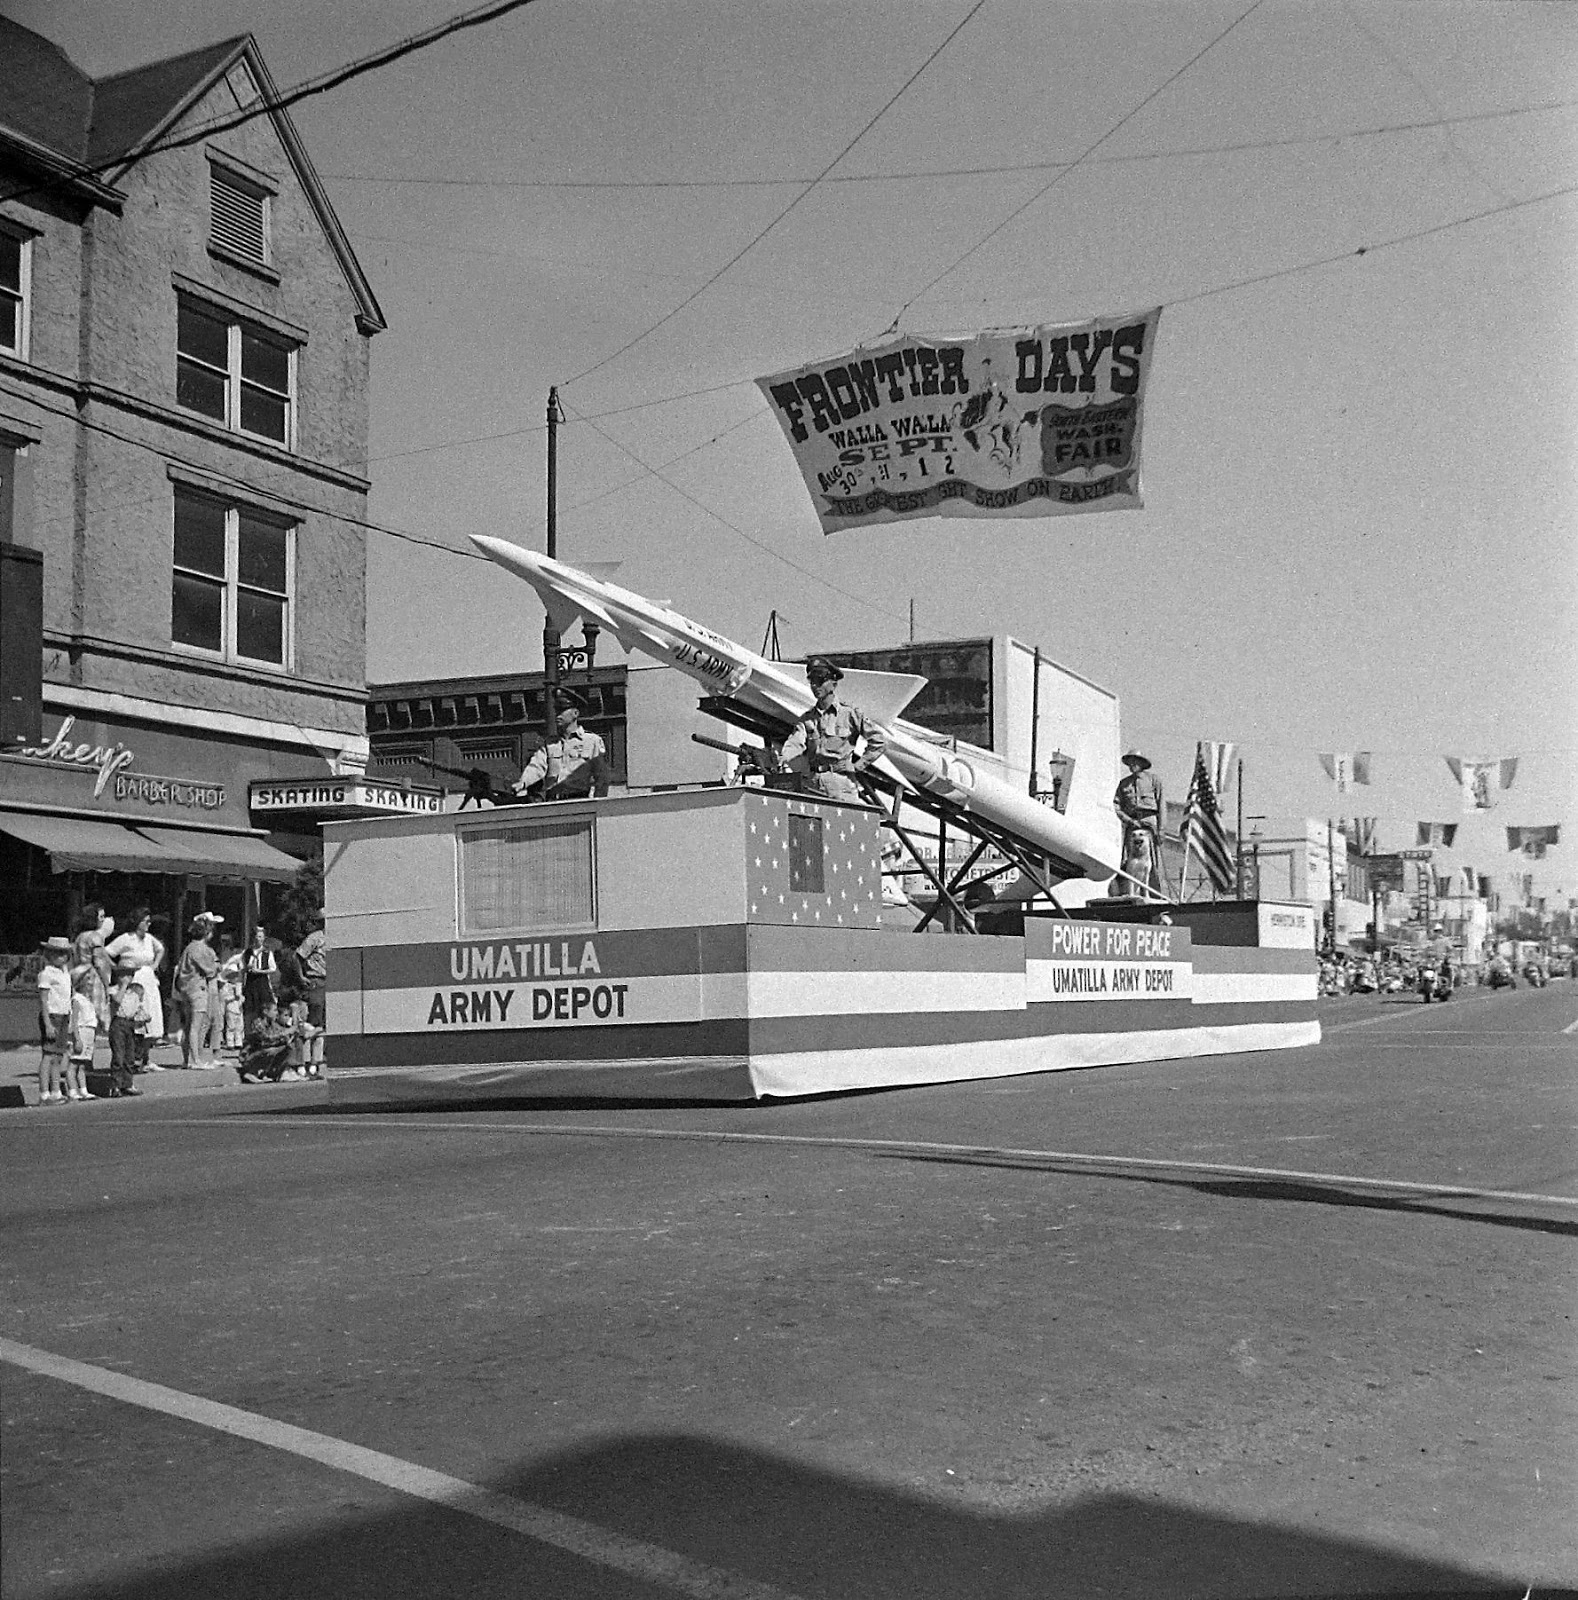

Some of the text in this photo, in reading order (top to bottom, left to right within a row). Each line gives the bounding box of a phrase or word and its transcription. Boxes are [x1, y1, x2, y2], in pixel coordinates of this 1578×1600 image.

[769, 323, 1146, 443] FRONTIER DAYS
[828, 424, 888, 450] WALLA
[838, 436, 958, 467] SEPT.
[1055, 437, 1122, 463] FAIR
[817, 464, 843, 492] AUG
[833, 500, 864, 516] THE
[975, 487, 1019, 508] SHOW
[1027, 479, 1051, 496] ON
[697, 655, 734, 679] ARMY
[116, 775, 227, 807] BARBER SHOP
[258, 787, 345, 805] SKATING
[365, 788, 438, 812] SKATING
[1052, 924, 1171, 957] POWER FOR PEACE
[451, 941, 601, 980] UMATILLA
[1053, 967, 1173, 993] UMATILLA ARMY DEPOT
[427, 984, 629, 1025] ARMY DEPOT
